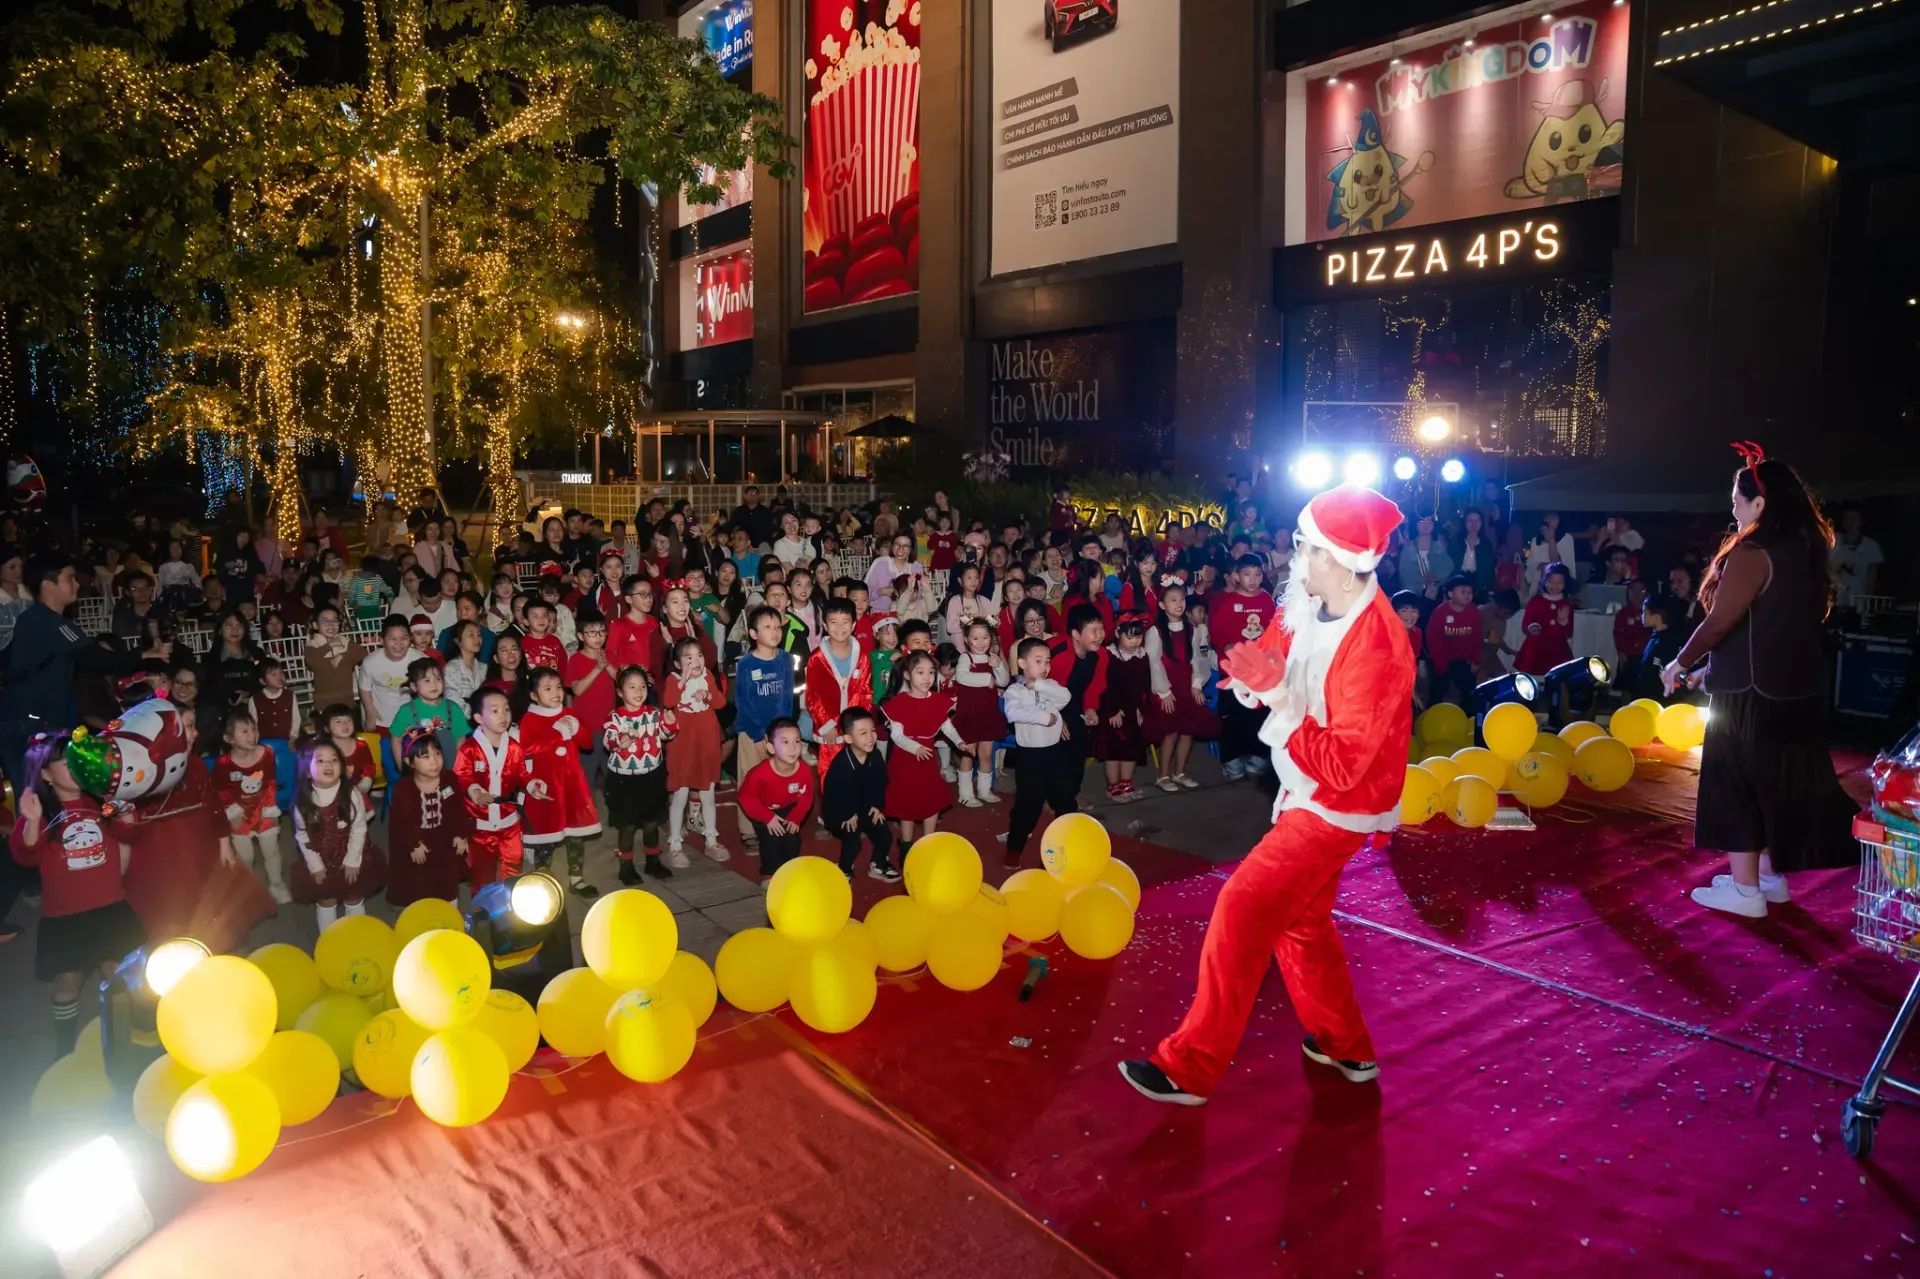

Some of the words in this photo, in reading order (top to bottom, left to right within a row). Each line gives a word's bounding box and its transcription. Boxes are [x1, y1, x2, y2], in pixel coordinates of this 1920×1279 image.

[734, 36, 743, 53] in
[1025, 147, 1042, 161] SÁCH
[1090, 177, 1108, 190] ngay
[1070, 188, 1127, 208] vinfastauto.com
[1071, 208, 1088, 221] 1900
[1089, 206, 1098, 217] 23
[1100, 203, 1109, 215] 23
[1110, 201, 1120, 212] 89
[1328, 239, 1448, 286] PIZZA
[1466, 221, 1560, 268] 4P'S
[991, 340, 1055, 381] Make
[990, 384, 1026, 424] the
[1030, 379, 1100, 421] World
[990, 426, 1055, 466] Smile
[561, 473, 592, 485] STARBUCKS
